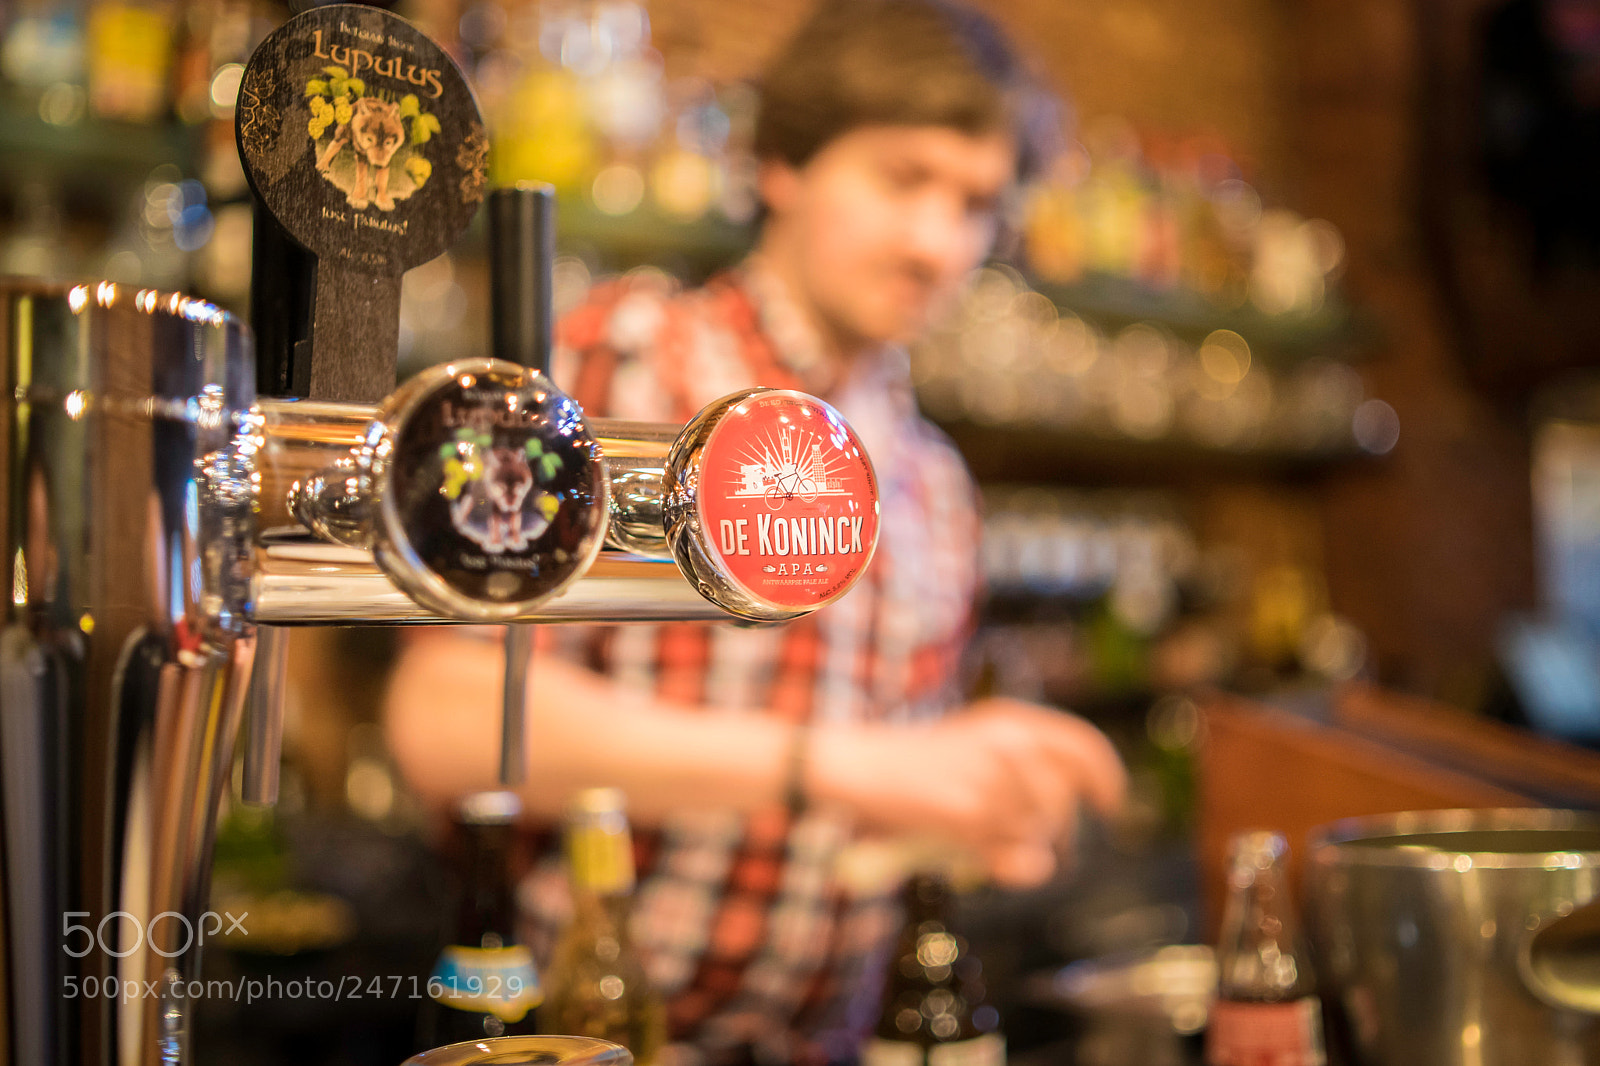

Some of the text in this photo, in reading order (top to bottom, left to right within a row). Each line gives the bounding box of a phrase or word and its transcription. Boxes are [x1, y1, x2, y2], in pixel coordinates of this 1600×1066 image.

[312, 29, 444, 99] Lupulus
[719, 513, 864, 556] DE KONINCK
[803, 577, 818, 586] PALE
[818, 577, 829, 585] ALE
